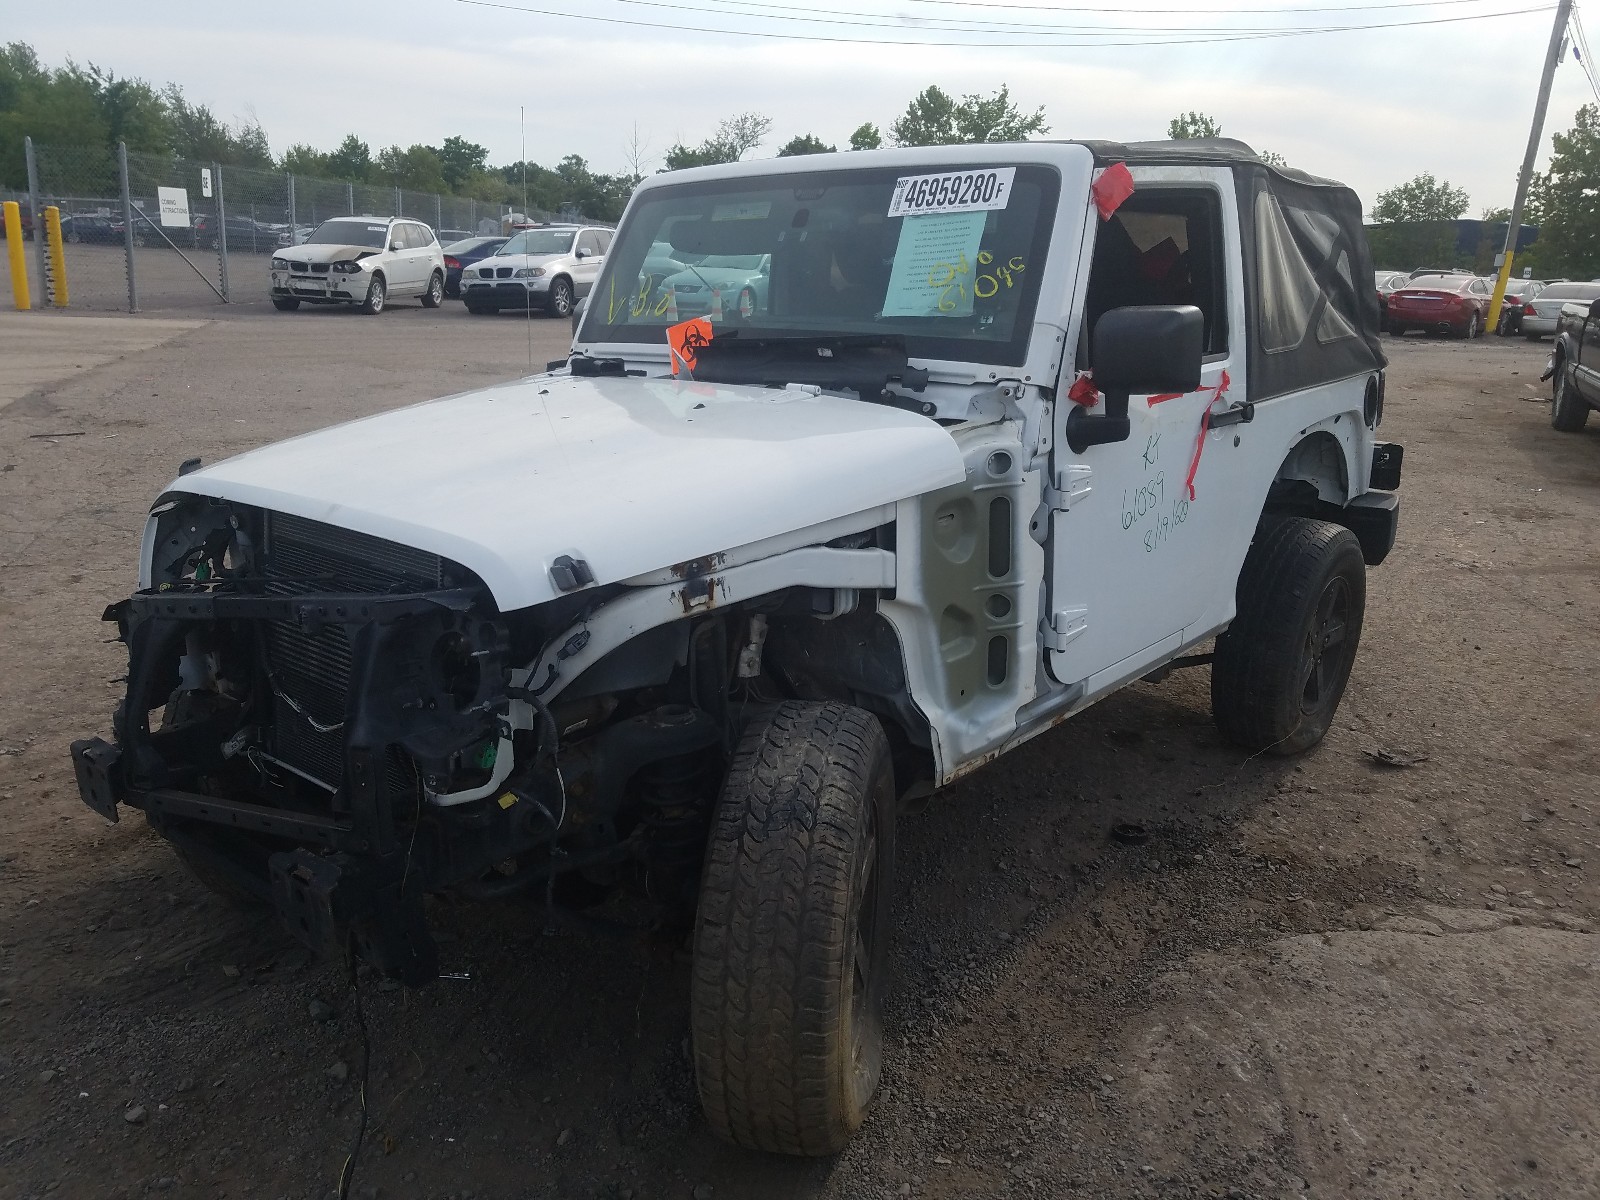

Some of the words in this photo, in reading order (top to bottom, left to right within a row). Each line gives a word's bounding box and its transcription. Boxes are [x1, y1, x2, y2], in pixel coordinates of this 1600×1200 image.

[904, 173, 997, 209] 46959280
[995, 182, 1005, 199] F
[162, 207, 188, 215] ATTRACTIONS
